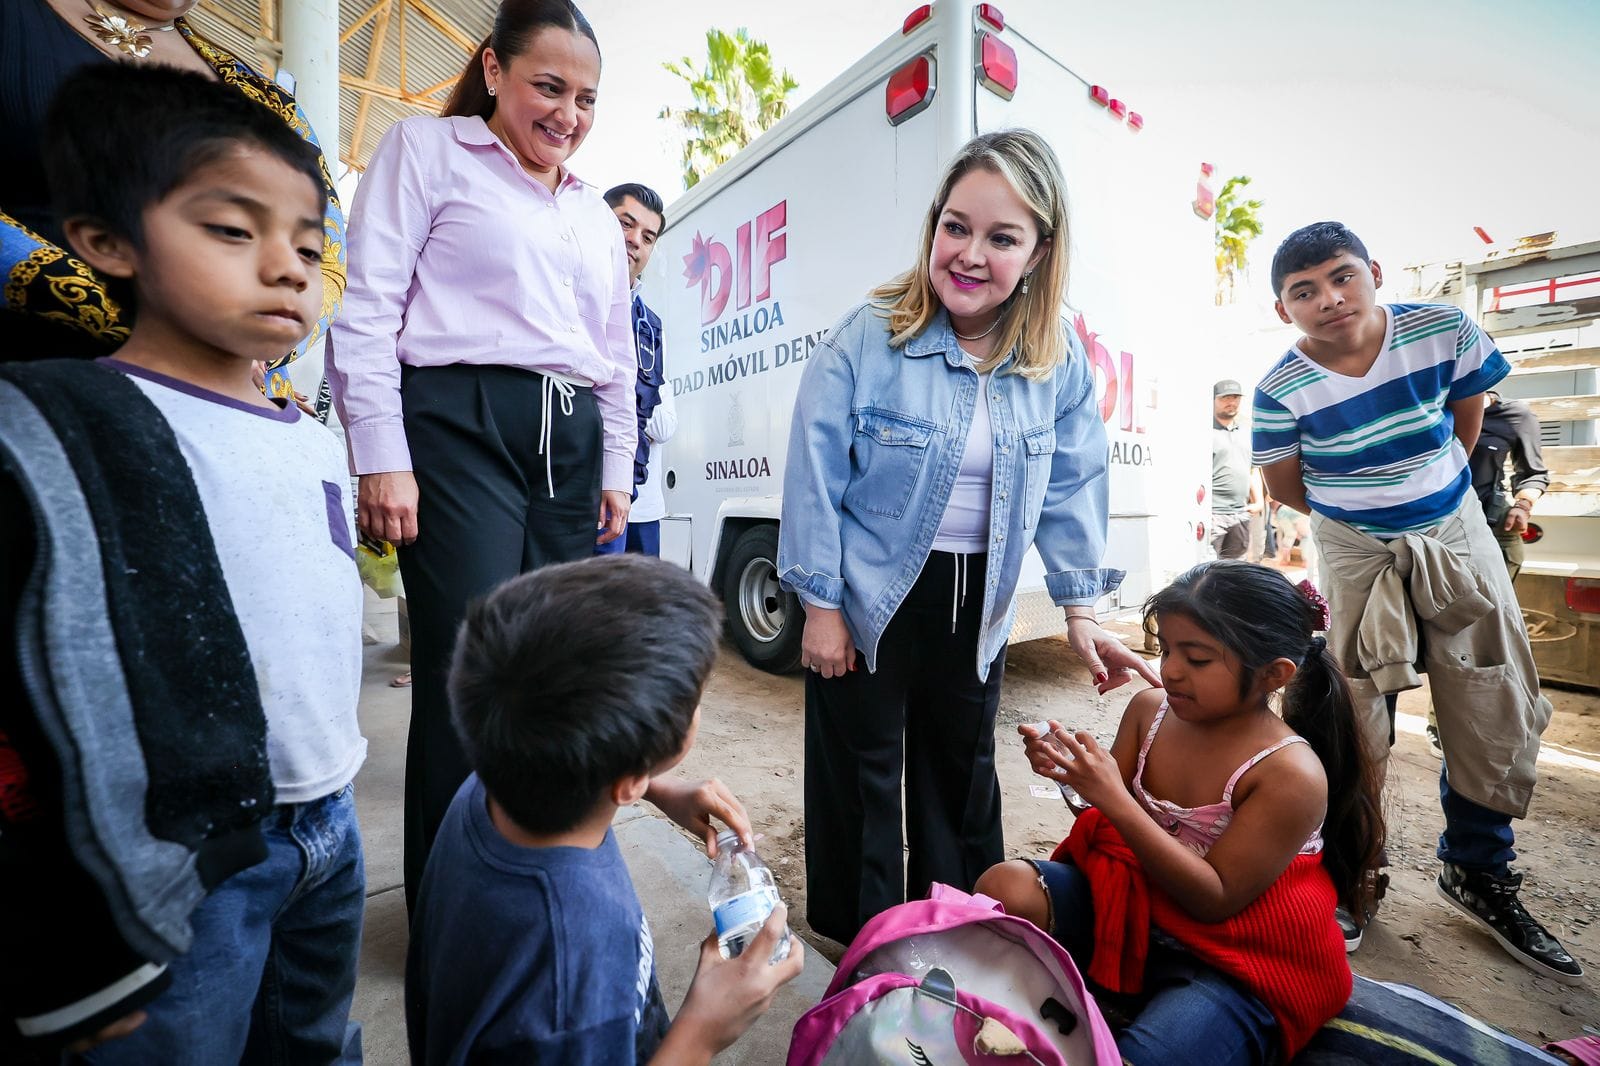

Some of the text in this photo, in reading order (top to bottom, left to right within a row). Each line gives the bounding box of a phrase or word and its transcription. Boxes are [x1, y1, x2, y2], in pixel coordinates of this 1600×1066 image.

[700, 199, 787, 327] DIF
[701, 301, 785, 353] SINALOA
[668, 328, 829, 397] DAD MÓVIL DEN
[705, 456, 772, 480] SINALOA
[1107, 440, 1153, 466] ALOA
